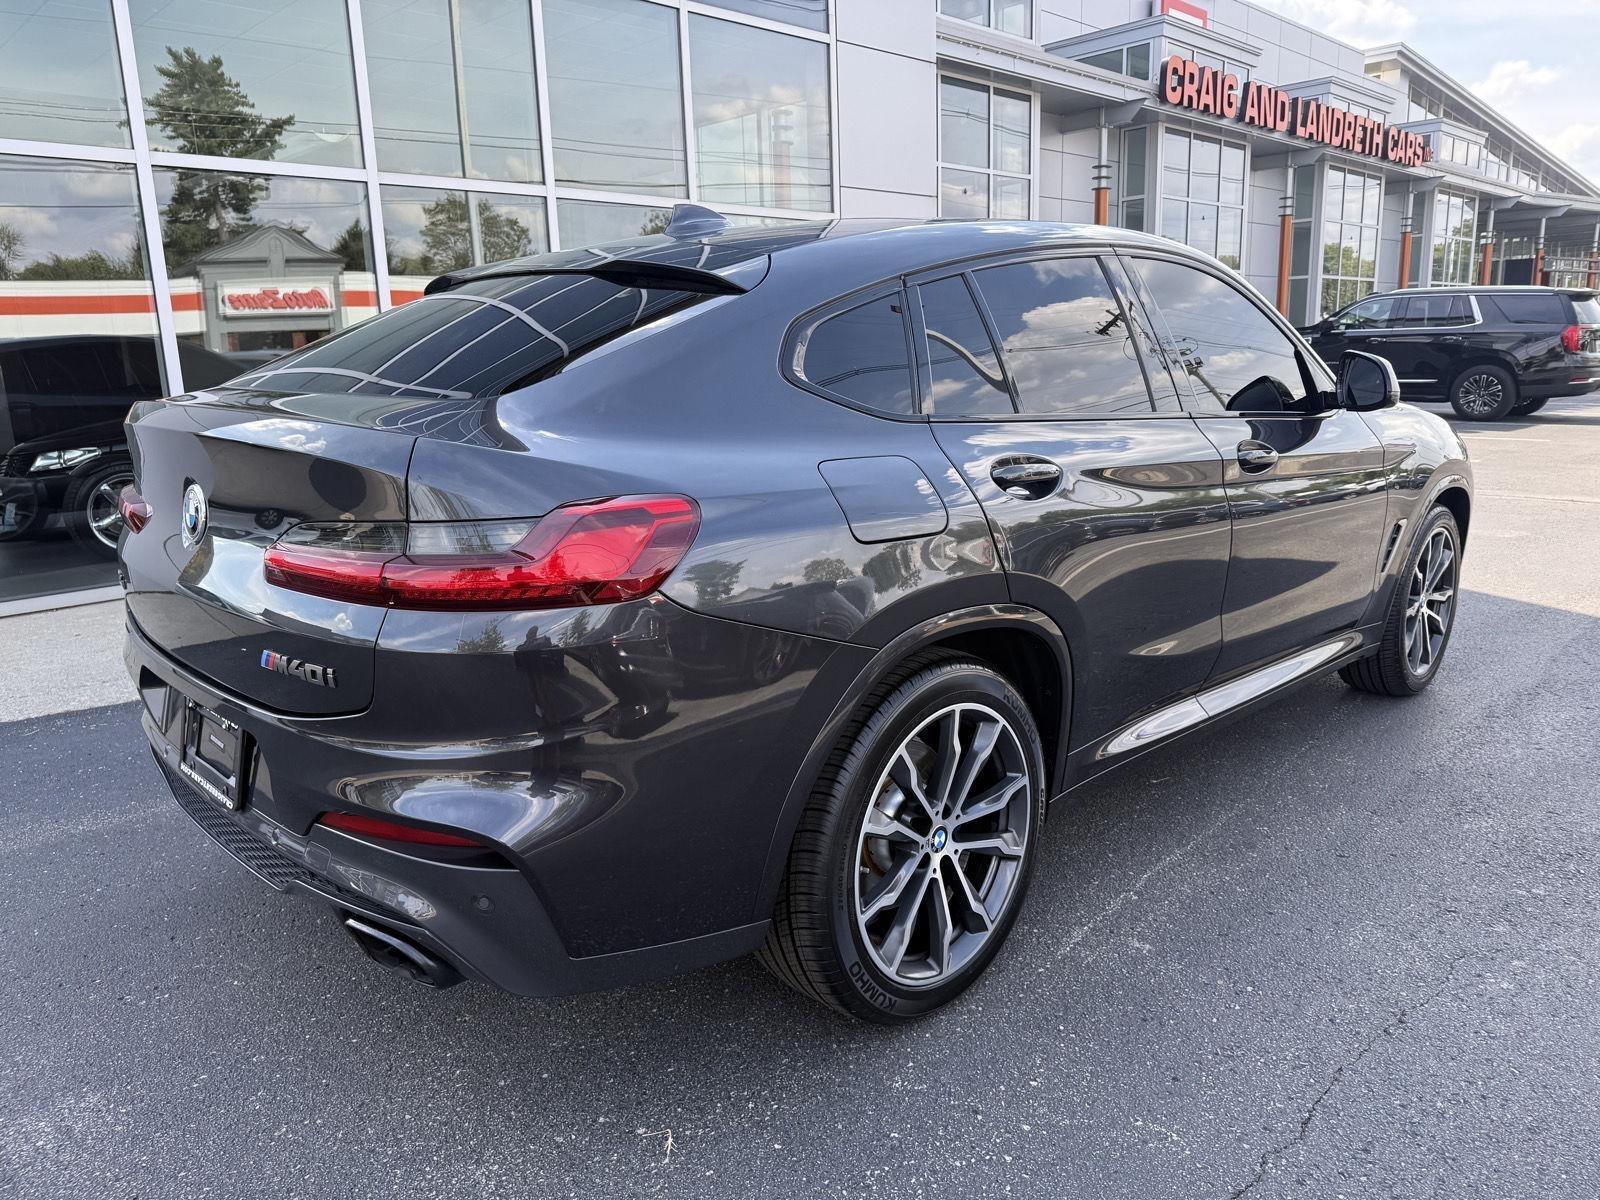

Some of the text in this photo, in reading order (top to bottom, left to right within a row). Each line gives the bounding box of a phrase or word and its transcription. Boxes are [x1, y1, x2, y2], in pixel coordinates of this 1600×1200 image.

[1160, 55, 1239, 118] CRAIG
[1242, 80, 1289, 132] AND
[1294, 96, 1384, 157] LANDRETH
[1387, 126, 1424, 167] CARS
[272, 652, 337, 688] M40i
[848, 960, 898, 1009] KUMHO
